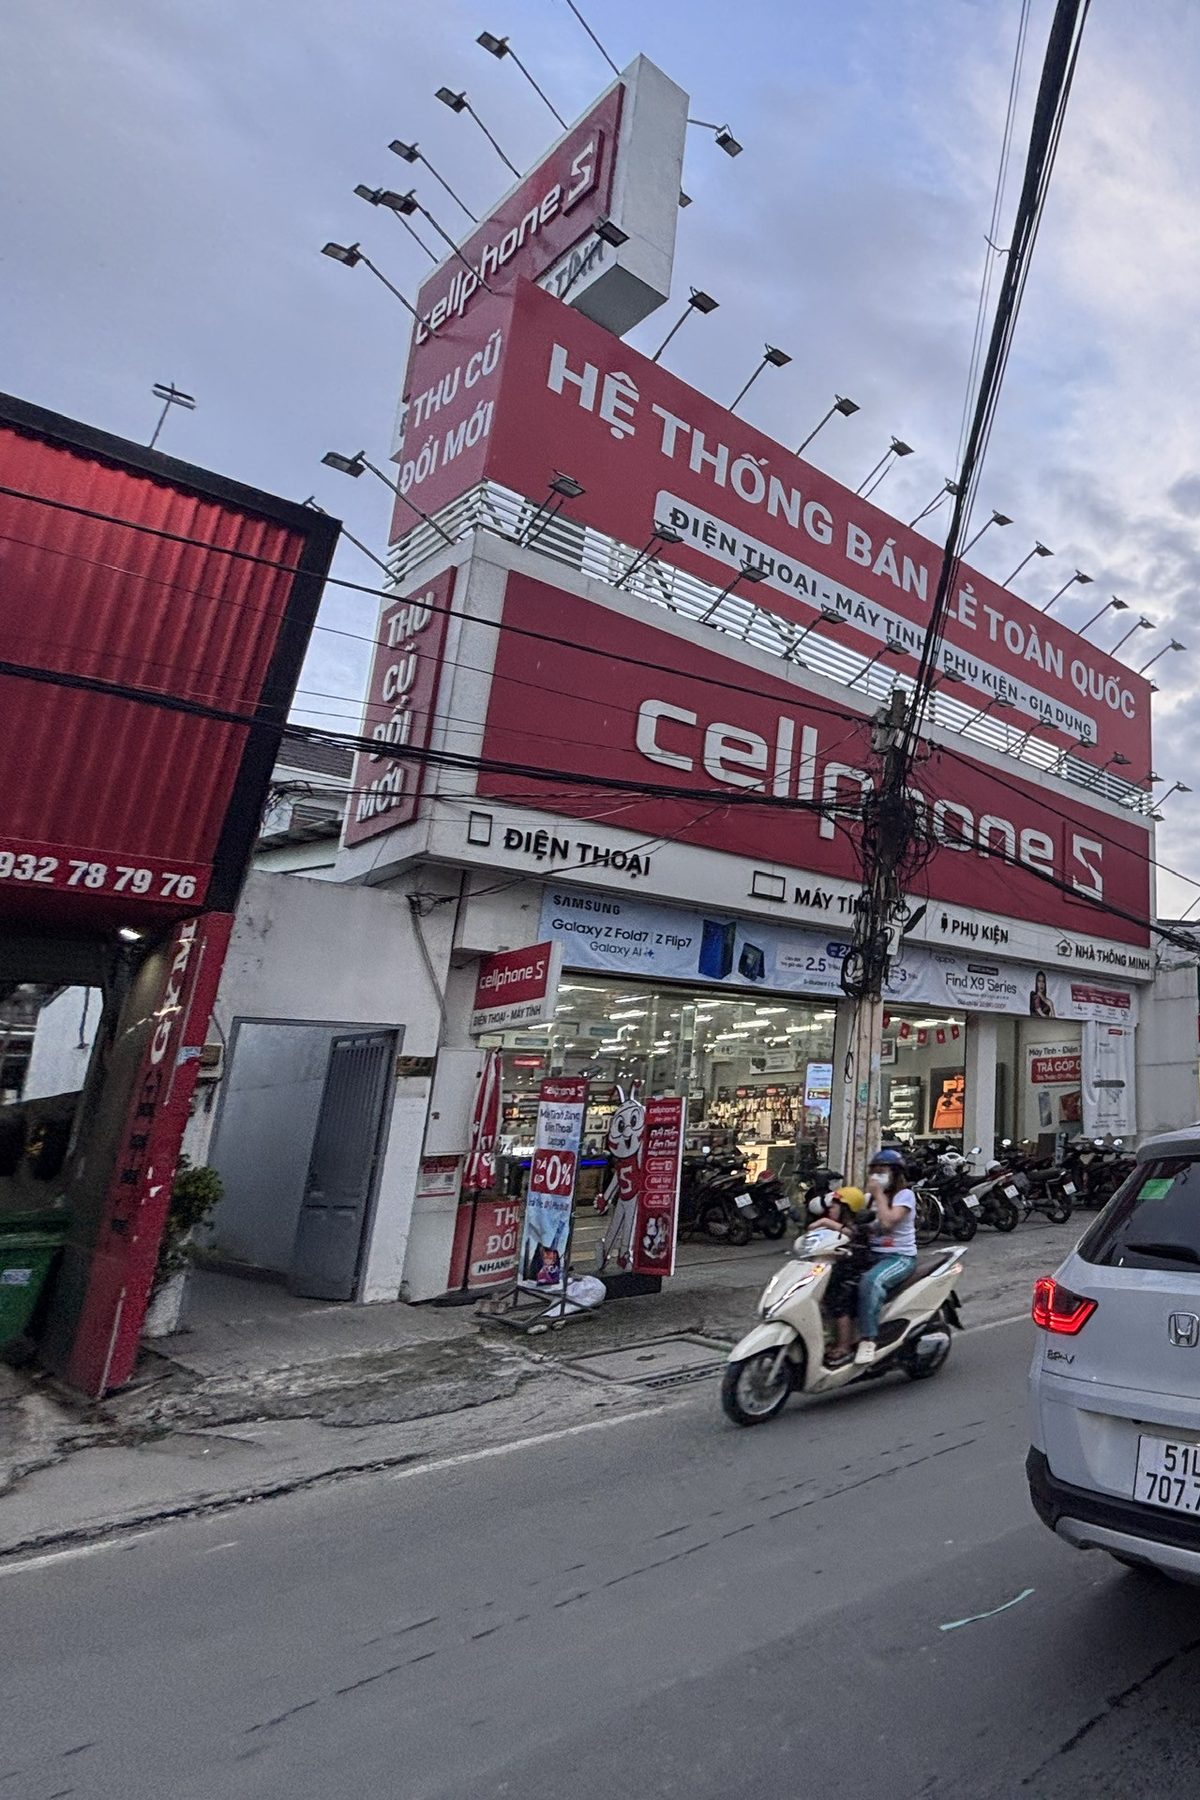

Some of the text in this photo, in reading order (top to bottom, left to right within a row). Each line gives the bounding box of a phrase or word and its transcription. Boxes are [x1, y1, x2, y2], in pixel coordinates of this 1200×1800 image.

[414, 329, 501, 428] THU CŨ
[401, 398, 494, 493] ĐỔI MỚI
[547, 342, 640, 439] HỆ
[651, 403, 834, 545] THỐNG
[846, 522, 928, 602] BÁN
[984, 603, 1064, 681] TOÀN
[1071, 660, 1136, 720] QUỐC
[388, 591, 435, 650] THU
[669, 507, 737, 555] ĐIỆN
[743, 543, 819, 598] THOẠI
[835, 591, 880, 627] MÁY
[944, 649, 979, 681] PHỤ
[982, 670, 1018, 699] KIỆN
[1030, 695, 1052, 719] GIA
[1055, 709, 1092, 736] DỤNG
[382, 643, 418, 702] CŨ
[356, 761, 404, 824] MỚI
[504, 828, 651, 878] ĐIỆN THOẠI
[67, 859, 108, 889] 78
[113, 866, 153, 894] 79
[160, 872, 197, 899] 76
[553, 894, 621, 916] SAMSUNG
[794, 887, 834, 910] MÁY
[552, 918, 693, 950] Galaxy Z Fold7 Z Flip7
[589, 941, 631, 957] Galaxy
[952, 919, 1009, 946] PHỤ KIỆN
[805, 956, 827, 972] 2.5
[1075, 944, 1150, 971] NHÀ THÔNG MINH
[945, 972, 1018, 995] Find X9 Series
[1055, 1058, 1074, 1072] GÓP
